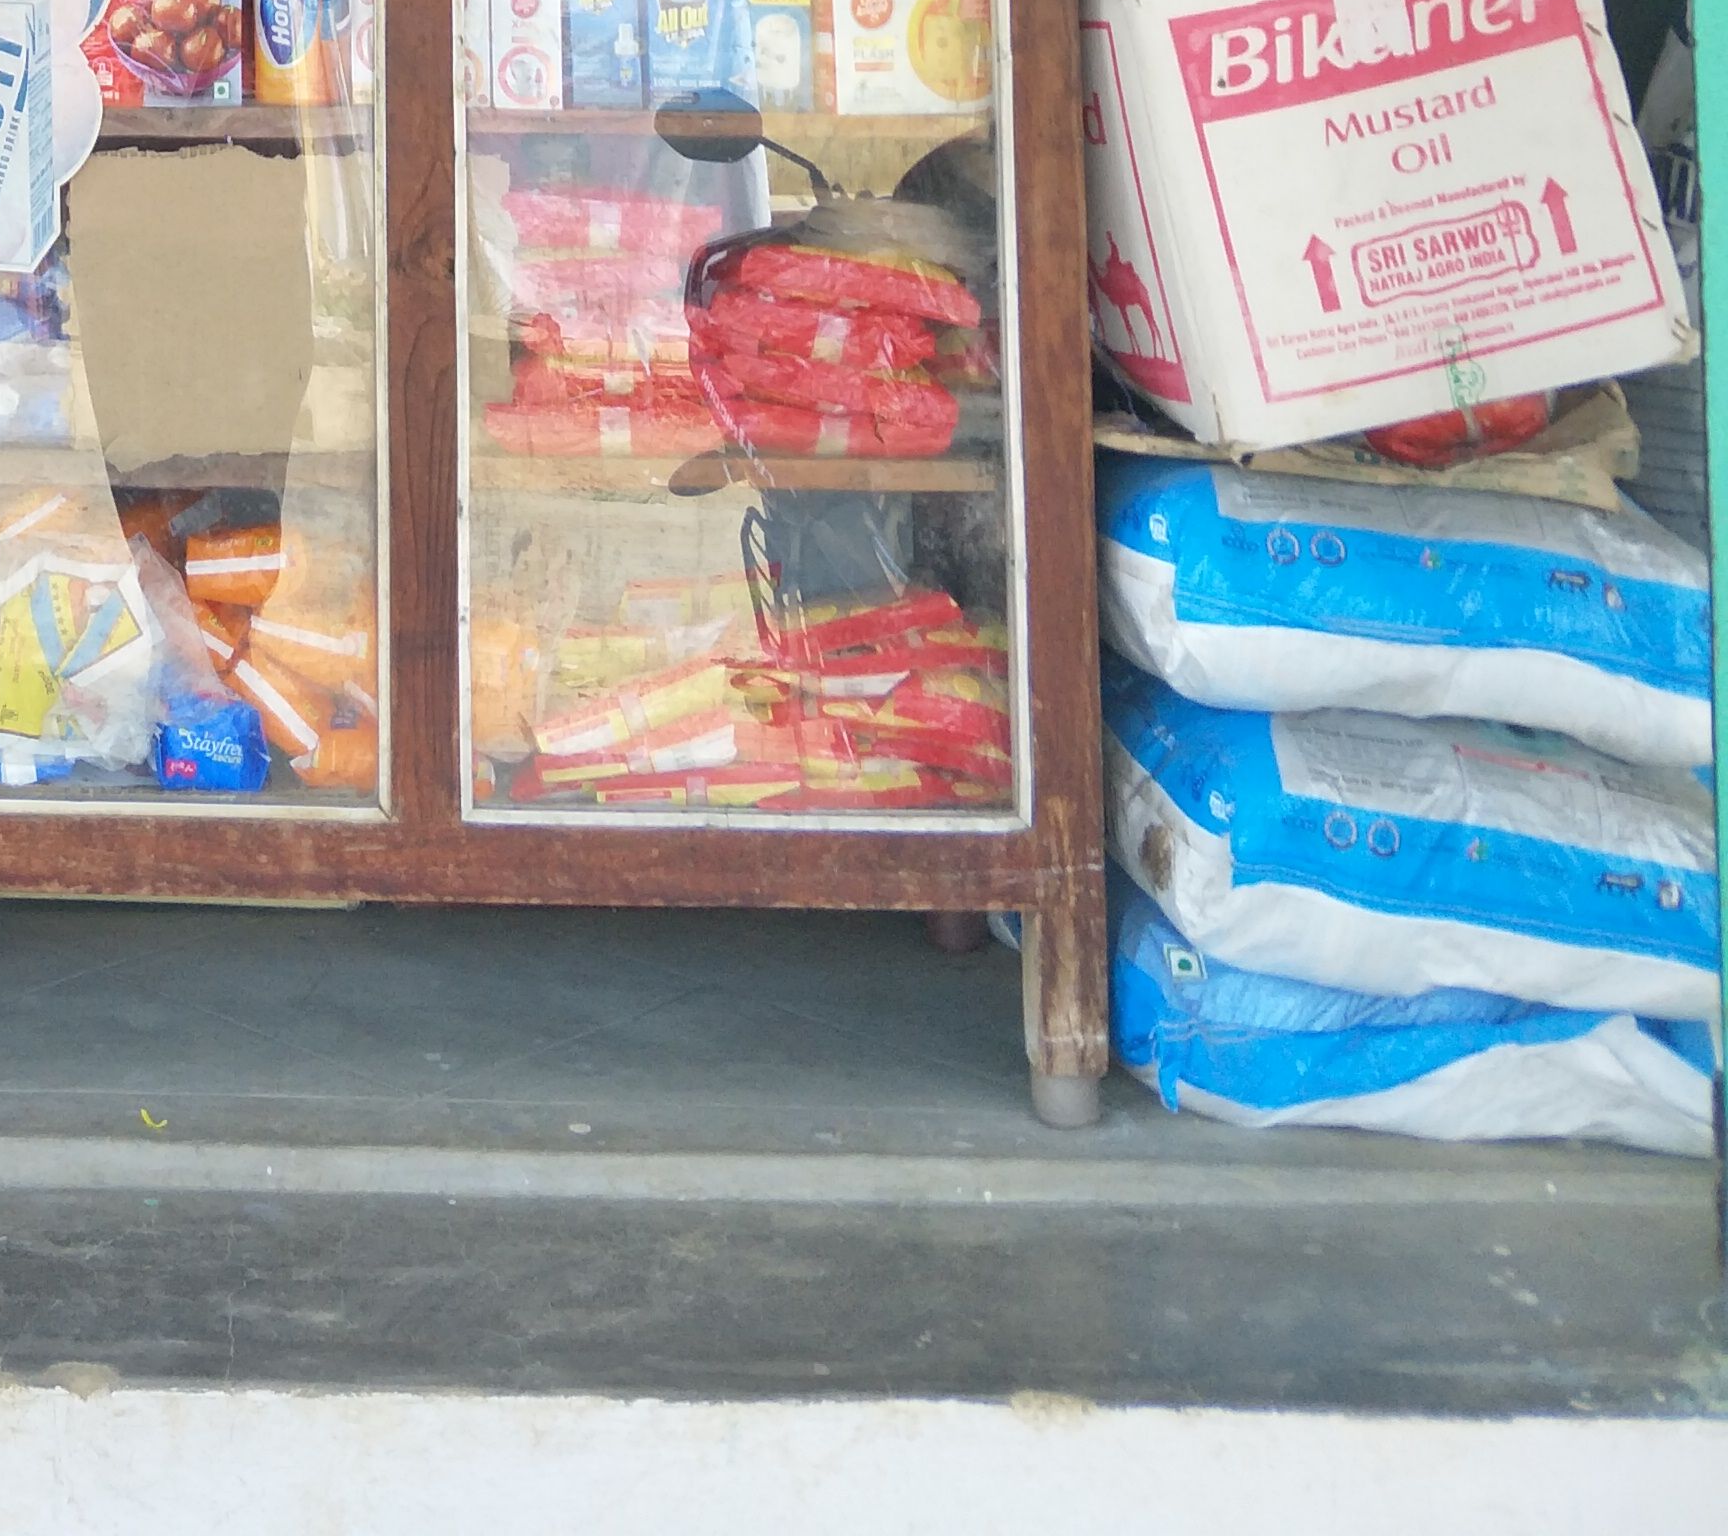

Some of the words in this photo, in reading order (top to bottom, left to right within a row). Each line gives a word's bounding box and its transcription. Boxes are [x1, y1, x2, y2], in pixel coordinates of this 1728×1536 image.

[3, 114, 22, 150] DRINK
[1323, 76, 1498, 148] Mustard
[1390, 132, 1454, 176] Oil
[1367, 243, 1408, 275] SRI
[1415, 219, 1499, 263] SARWO
[1368, 266, 1426, 294] NATRAJ
[1426, 257, 1466, 281] AGRO
[1469, 247, 1508, 272] INDIA
